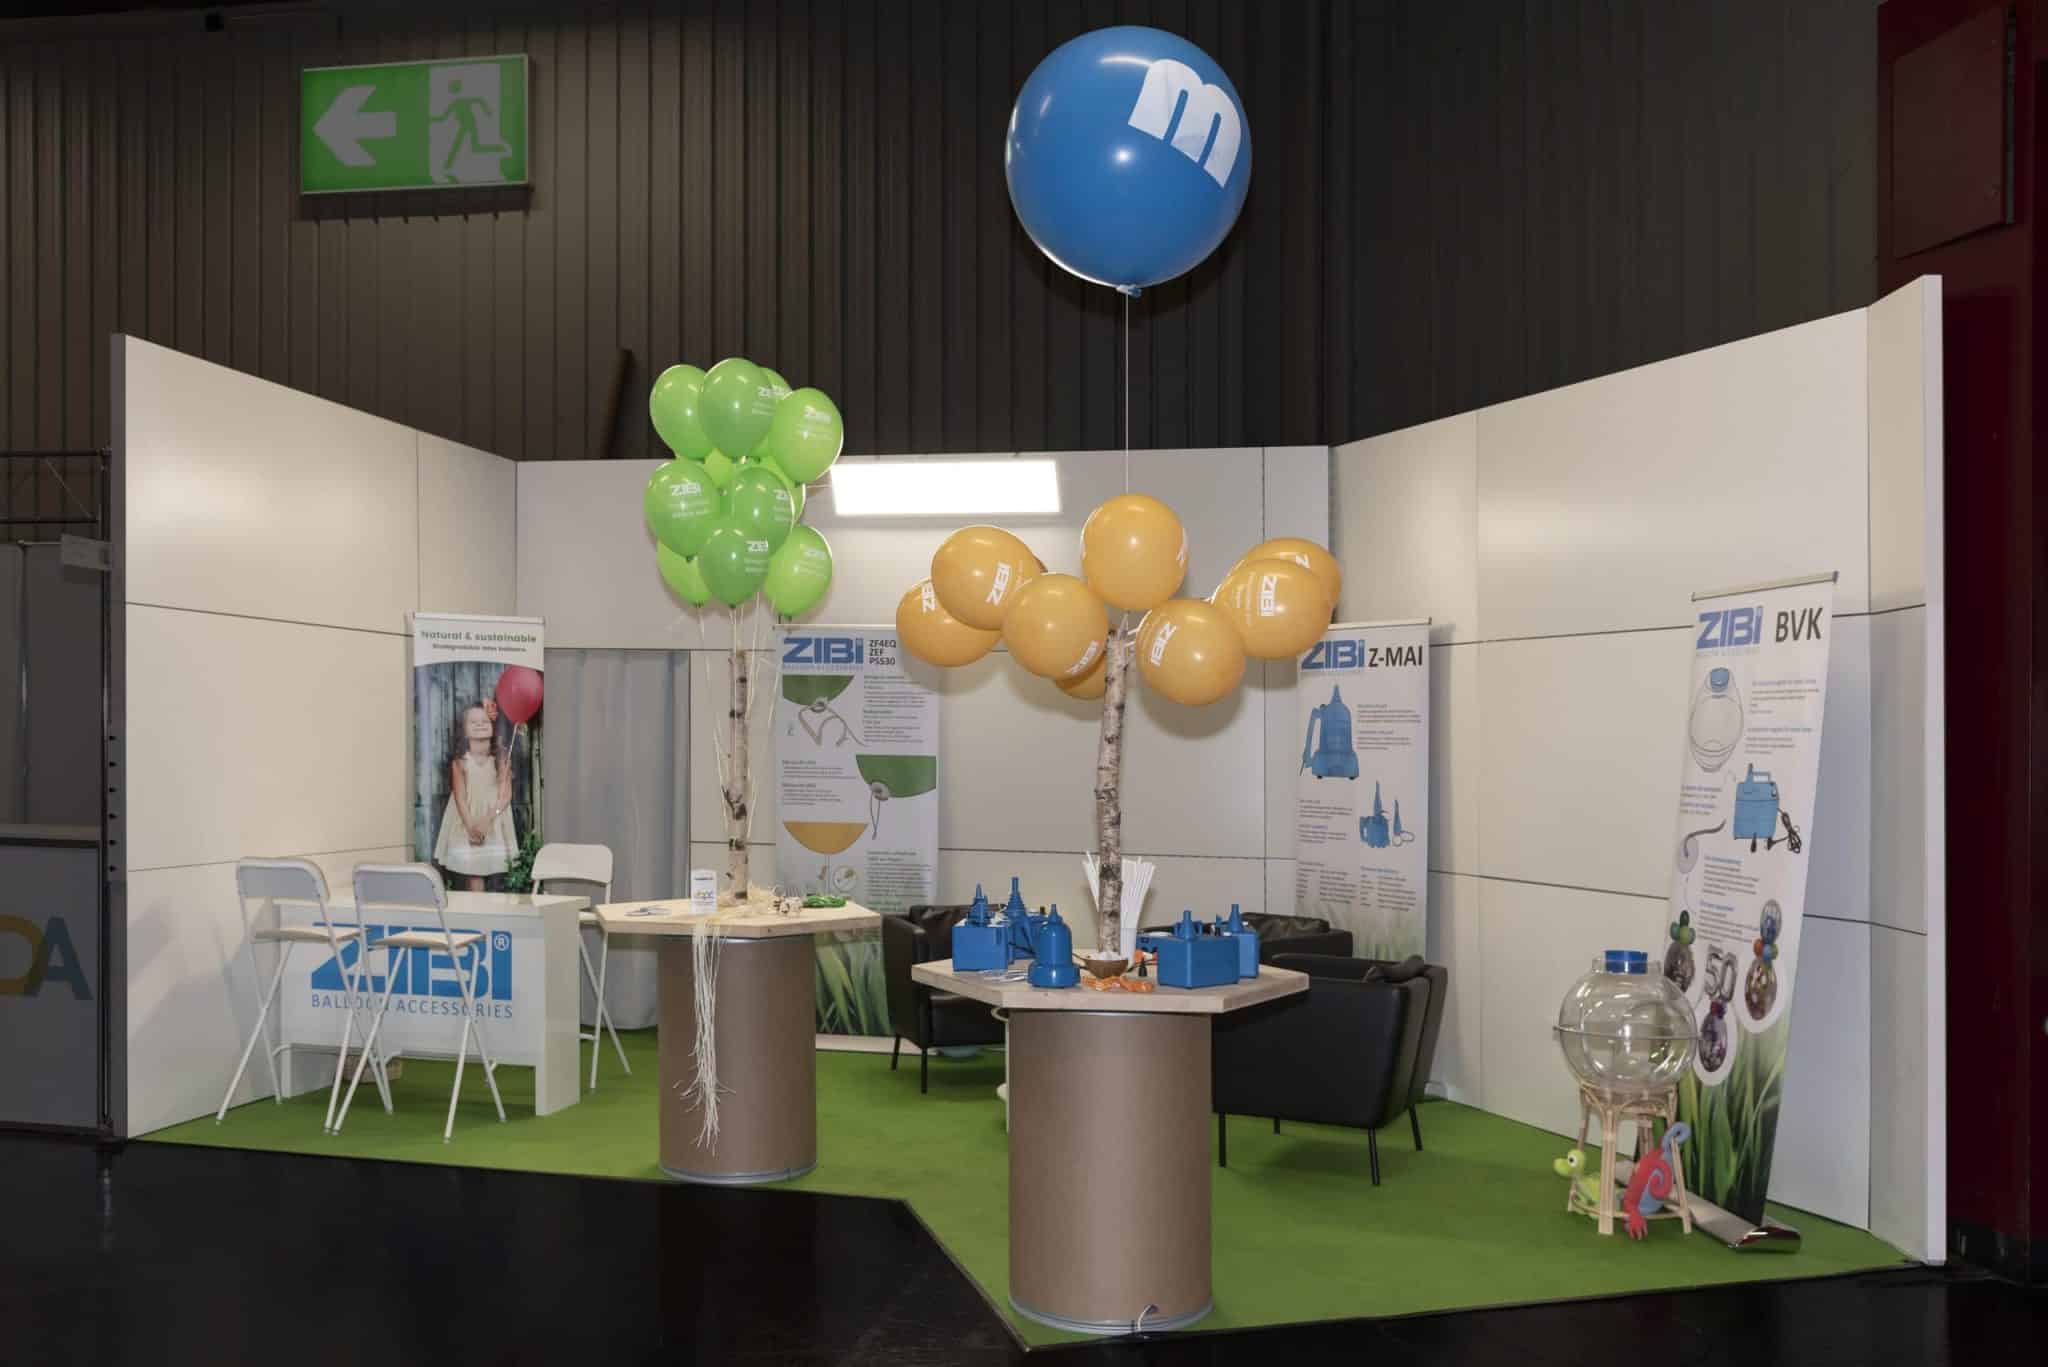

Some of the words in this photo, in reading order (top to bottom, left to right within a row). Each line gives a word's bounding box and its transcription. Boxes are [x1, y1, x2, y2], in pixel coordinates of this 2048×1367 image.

[1128, 58, 1242, 189] m
[920, 581, 937, 615] ZIB
[985, 560, 1012, 606] ZIBI
[1259, 575, 1278, 617] ZIBI
[420, 630, 462, 641] Natural
[474, 632, 537, 644] sustainable
[1774, 606, 1824, 643] BVK
[1149, 622, 1179, 668] ZIBI
[1367, 644, 1423, 668] Z-MAI
